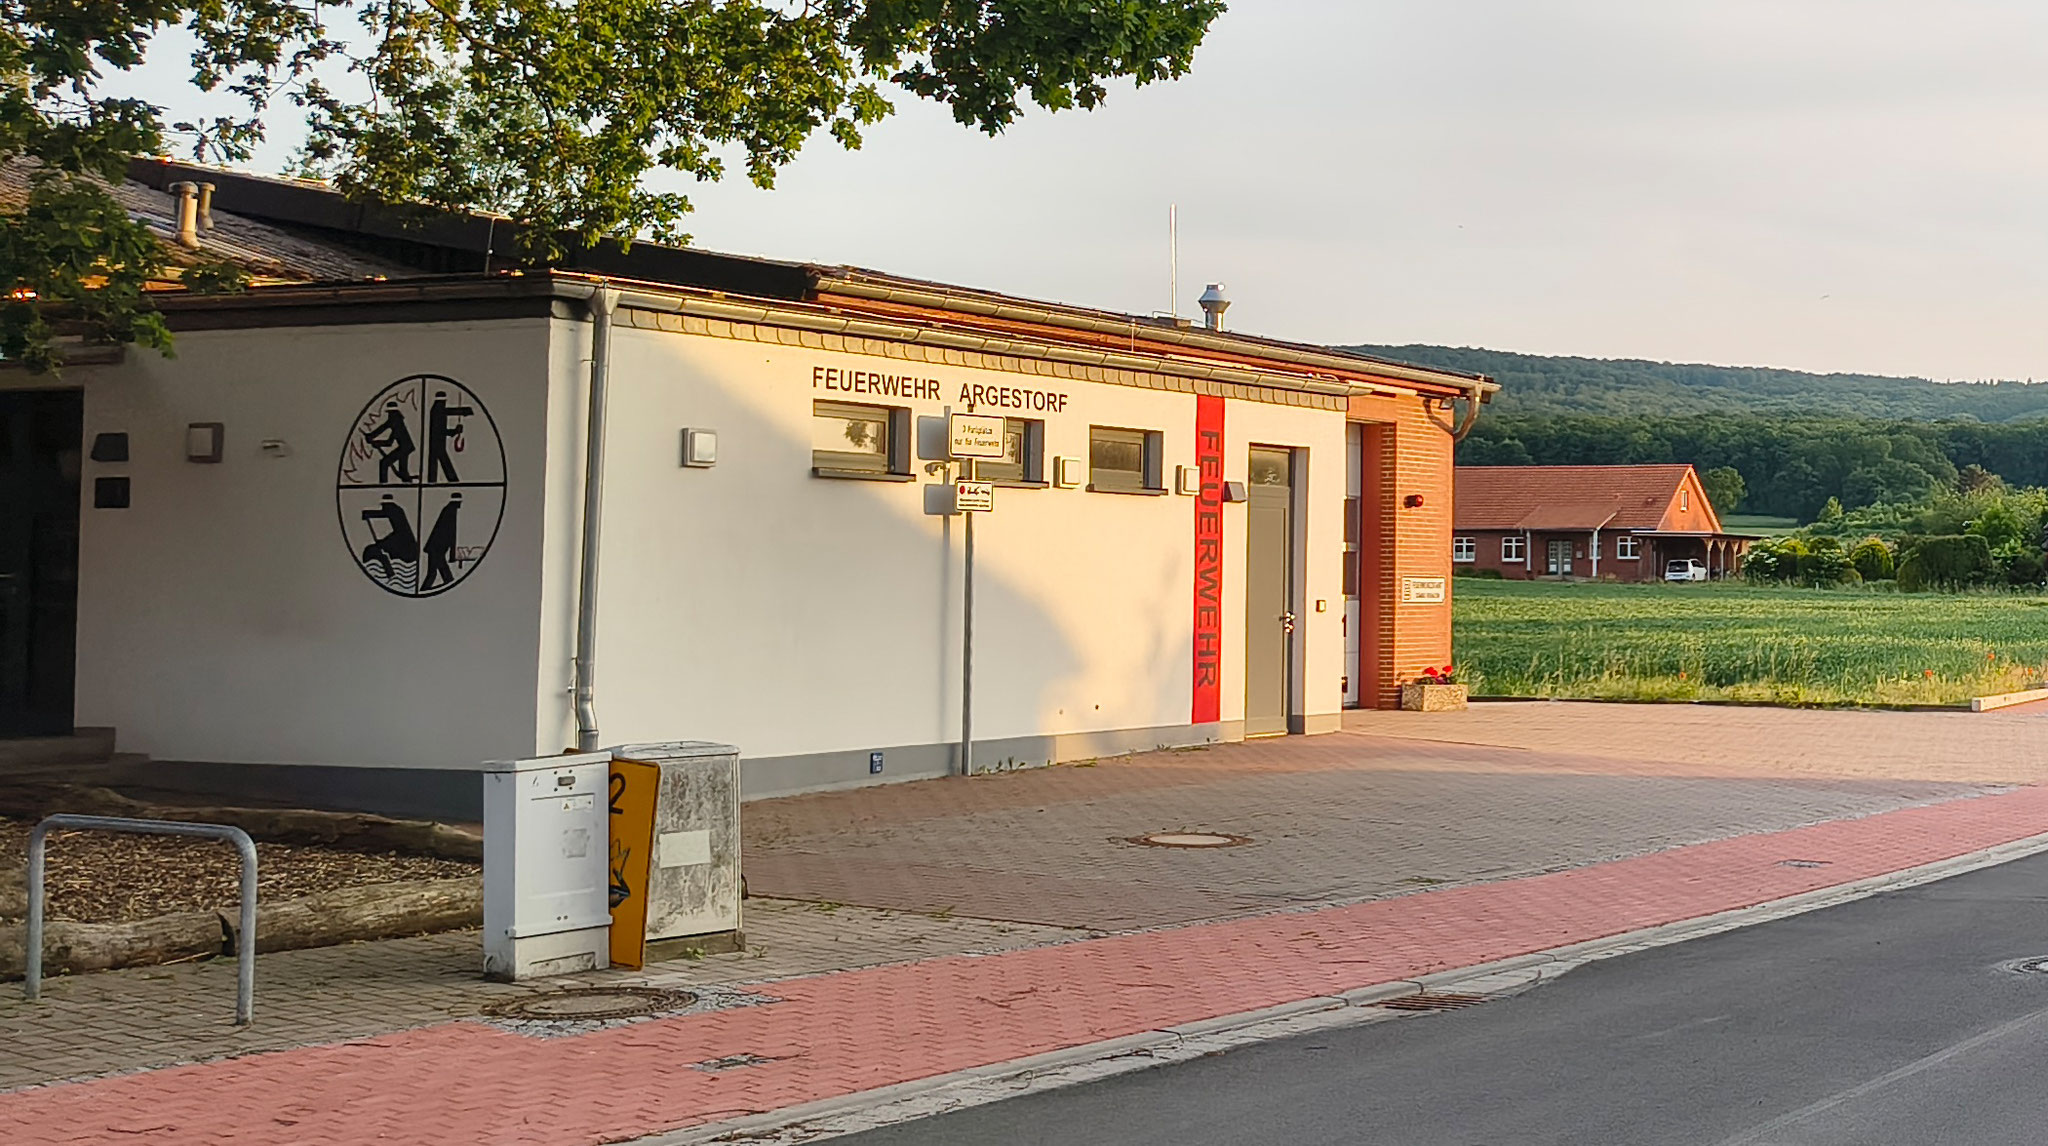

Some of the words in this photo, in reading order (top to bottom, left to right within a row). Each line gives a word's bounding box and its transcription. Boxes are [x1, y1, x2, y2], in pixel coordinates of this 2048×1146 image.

[812, 366, 941, 400] FEUERWEHR
[959, 383, 1068, 413] ARGESTORF
[1198, 430, 1220, 687] FEUERWEHR
